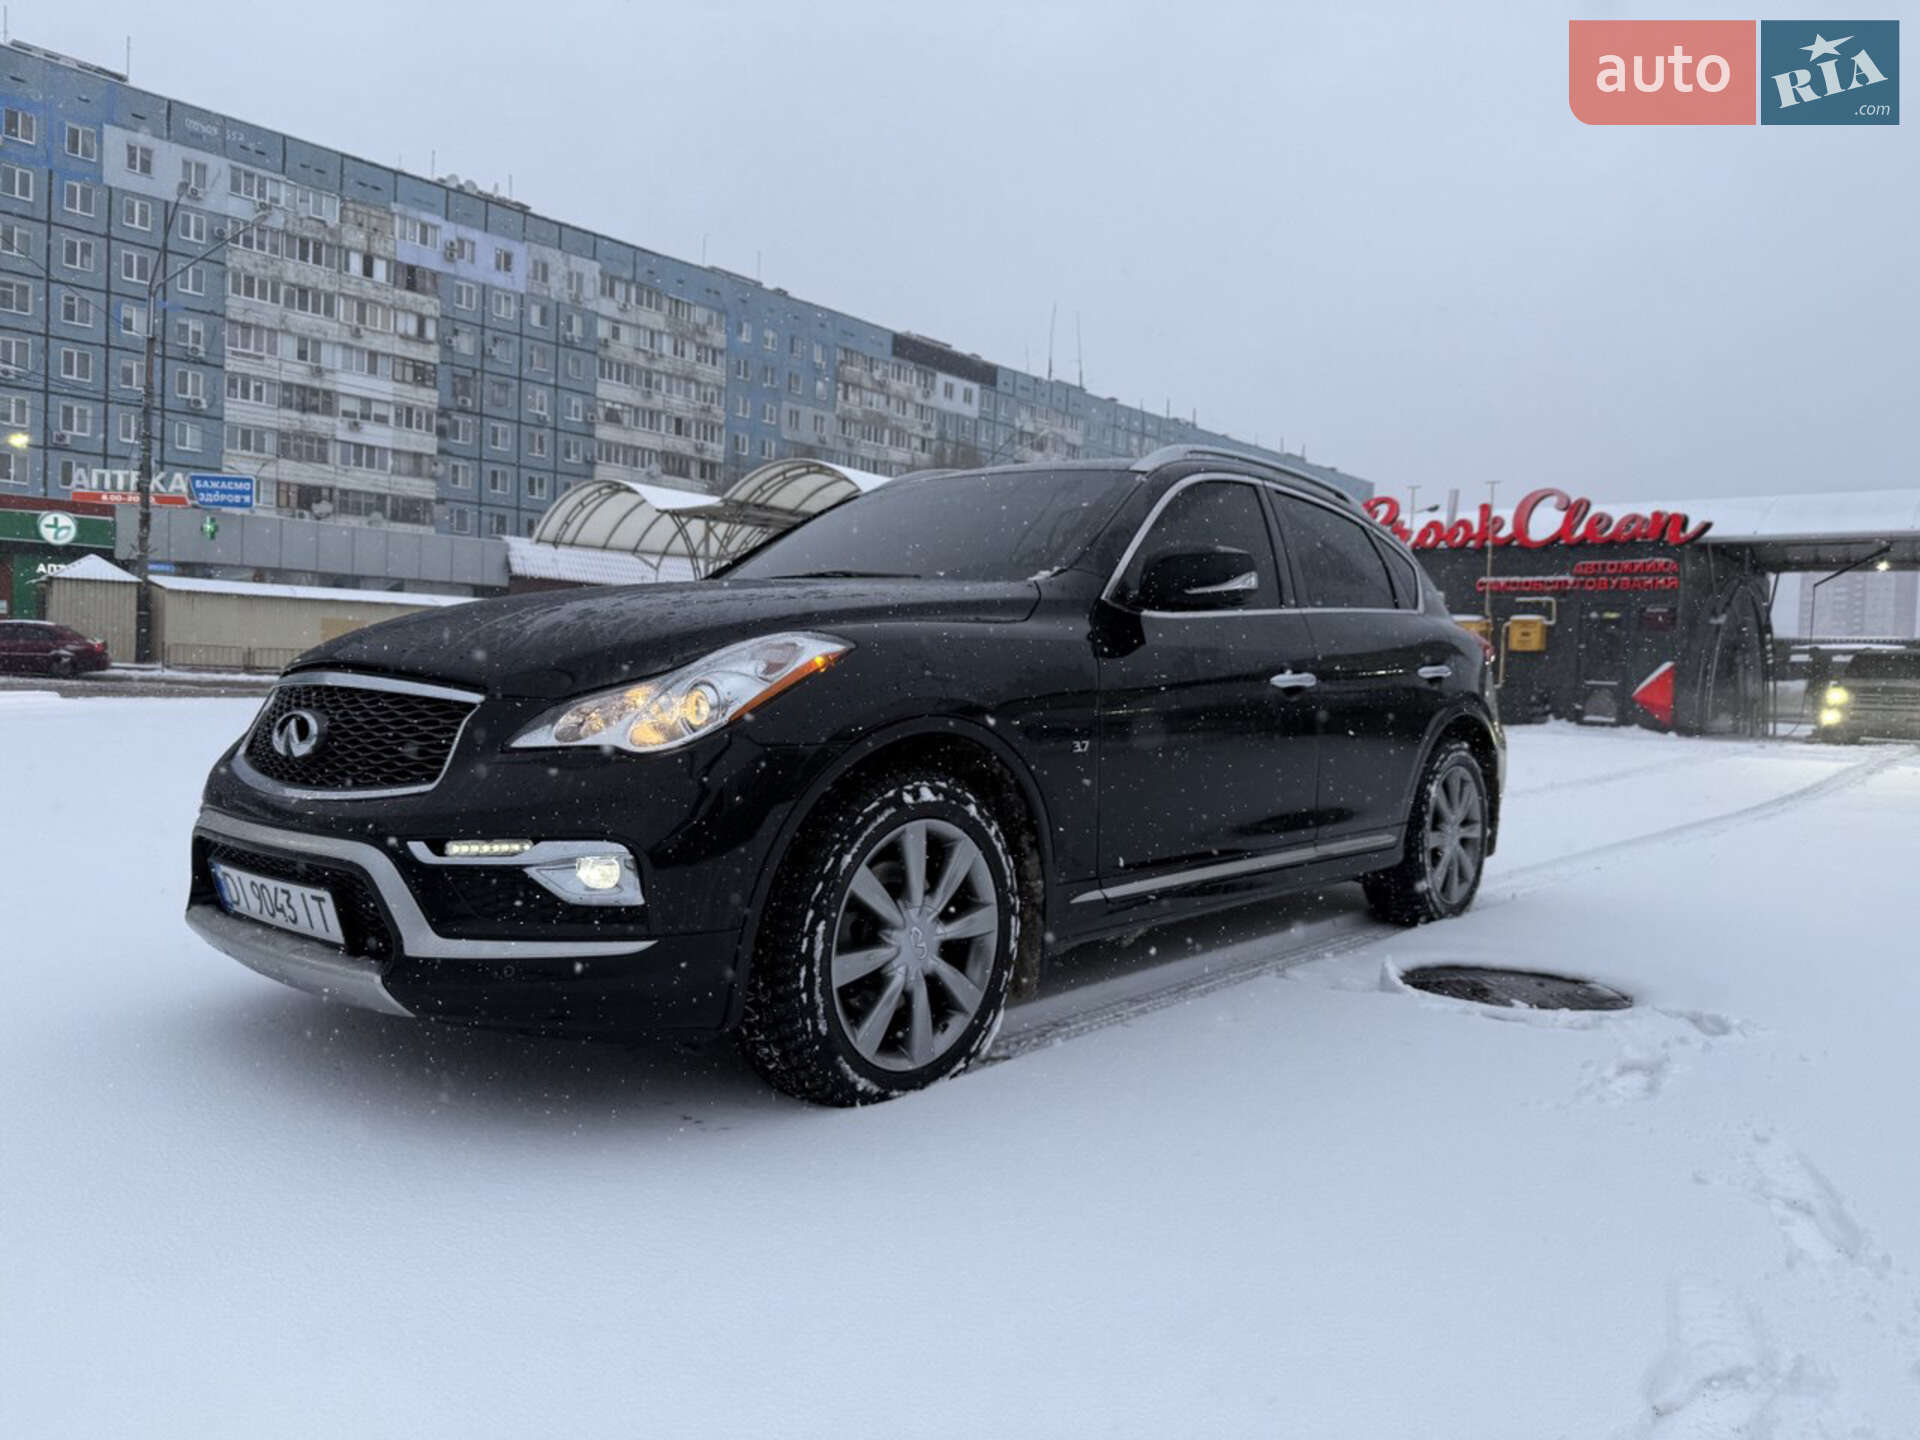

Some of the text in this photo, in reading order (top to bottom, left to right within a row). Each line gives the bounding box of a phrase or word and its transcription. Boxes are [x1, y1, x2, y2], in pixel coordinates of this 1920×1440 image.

[71, 468, 188, 493] АПТЕКА
[251, 880, 298, 924] 9043
[301, 892, 330, 933] IT
